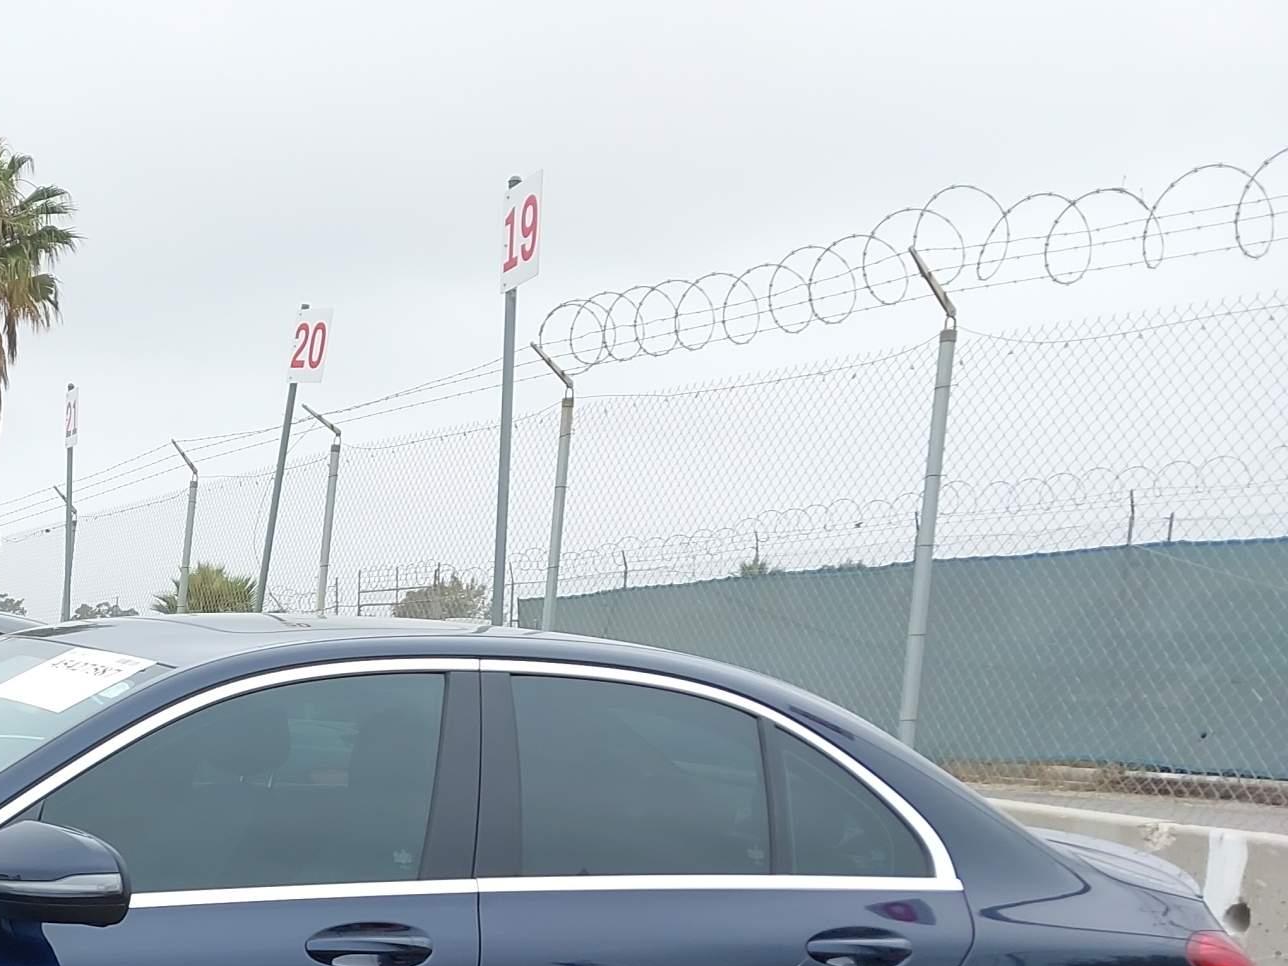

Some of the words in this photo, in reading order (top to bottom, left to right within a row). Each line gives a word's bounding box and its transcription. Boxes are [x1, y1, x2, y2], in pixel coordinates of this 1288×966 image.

[503, 194, 538, 272] 19
[290, 321, 327, 369] 20
[65, 399, 77, 437] 21
